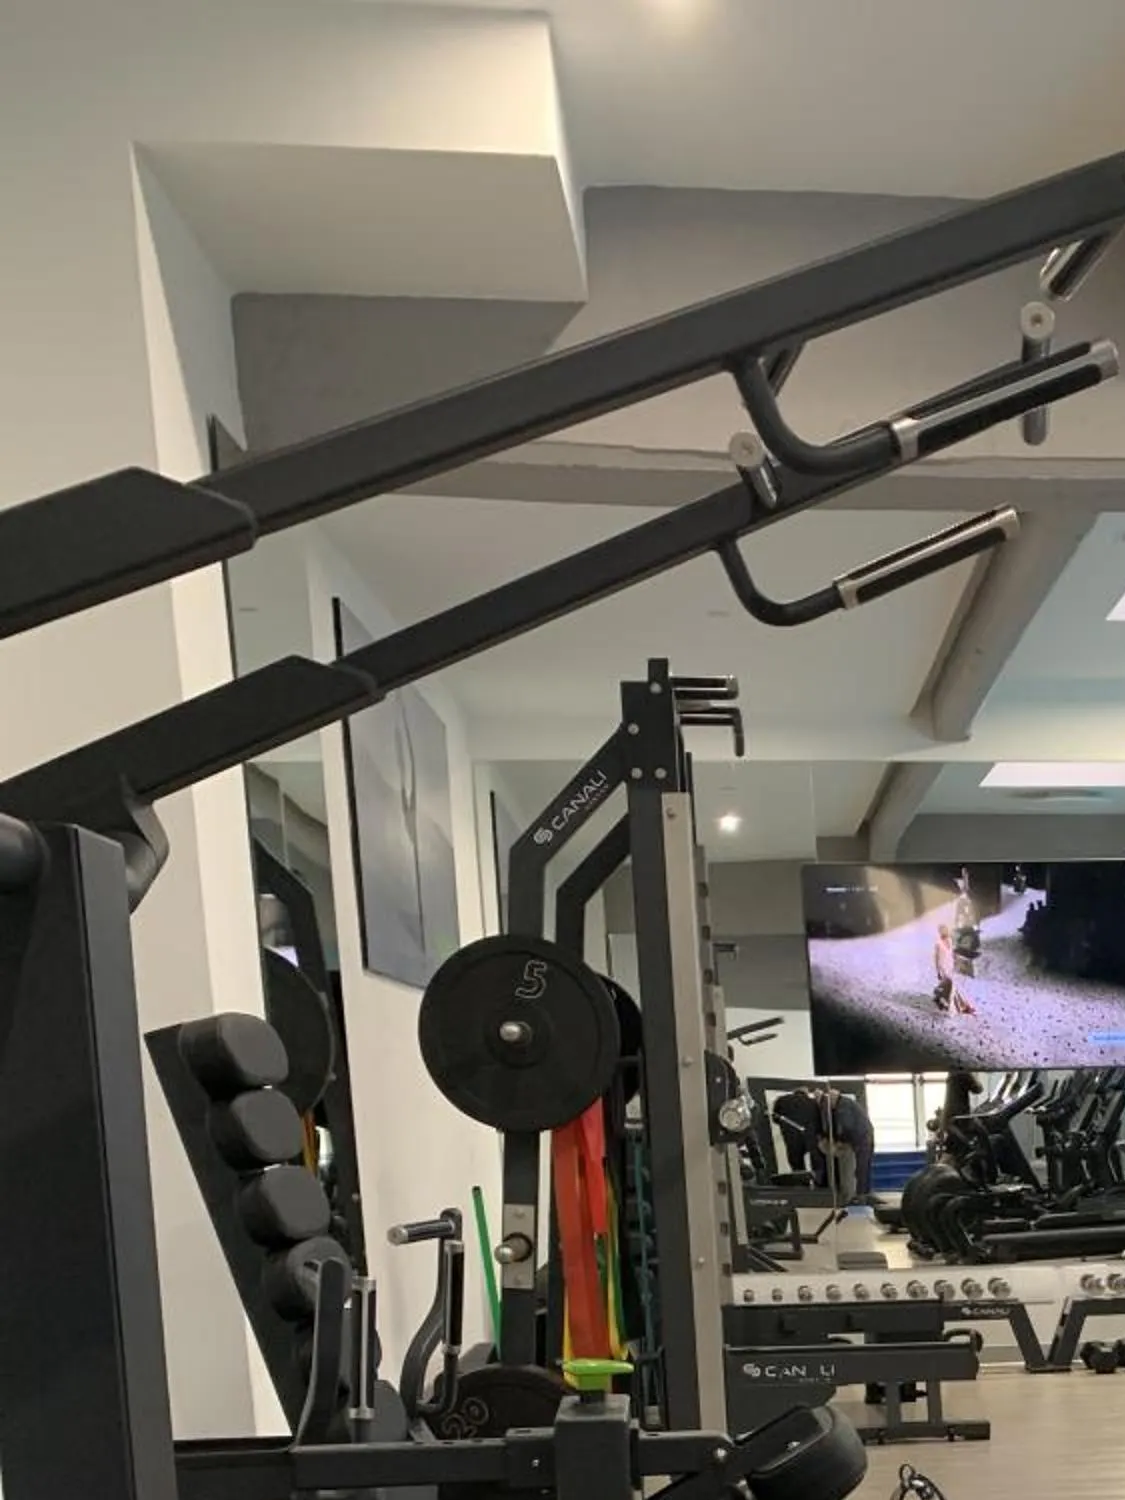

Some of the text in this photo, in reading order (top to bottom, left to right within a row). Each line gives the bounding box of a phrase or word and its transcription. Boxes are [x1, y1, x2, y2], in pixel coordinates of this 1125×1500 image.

[551, 769, 607, 831] CANALI
[514, 959, 548, 999] 5
[764, 1363, 835, 1378] CANLI
[441, 1396, 490, 1439] 20
